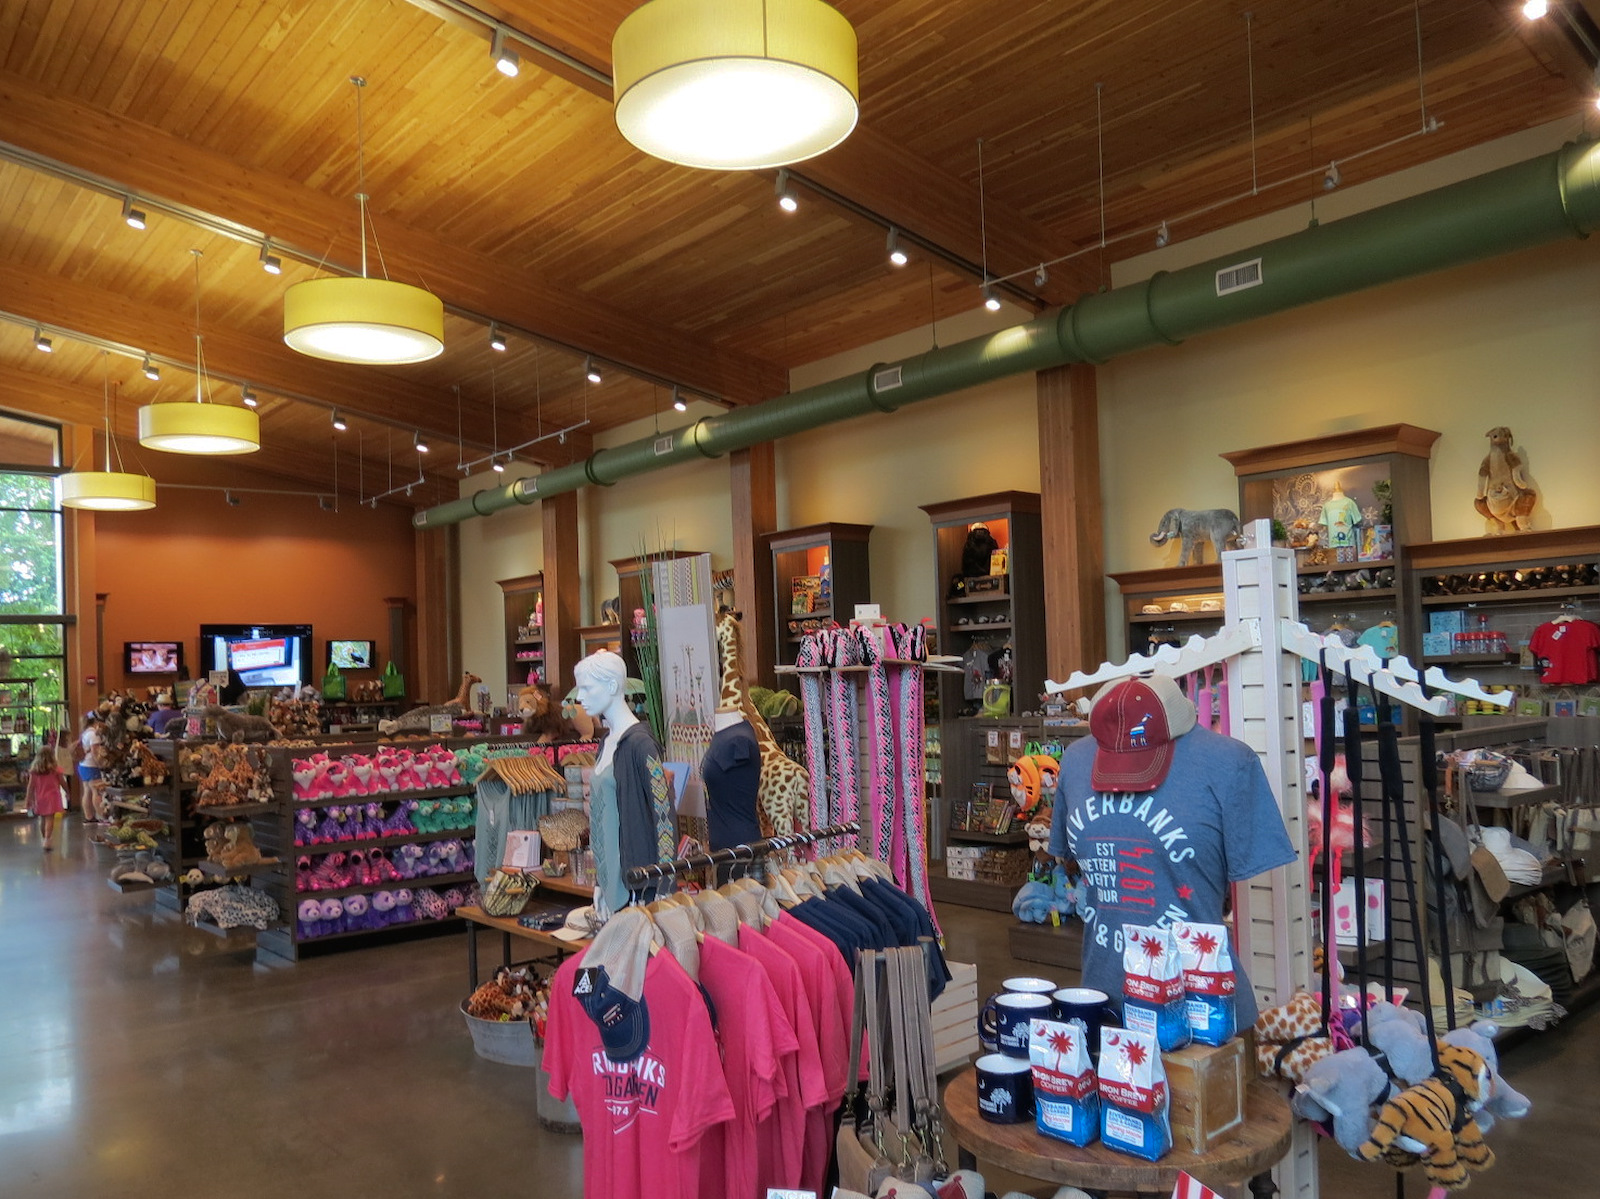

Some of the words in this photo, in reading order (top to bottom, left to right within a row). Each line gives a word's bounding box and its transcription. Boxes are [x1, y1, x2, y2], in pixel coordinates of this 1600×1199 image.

[1096, 842, 1115, 856] EST
[1118, 847, 1155, 907] 1974
[1099, 1082, 1120, 1096] IRON
[1121, 1087, 1148, 1102] BREW
[1107, 1093, 1138, 1106] COFFEE
